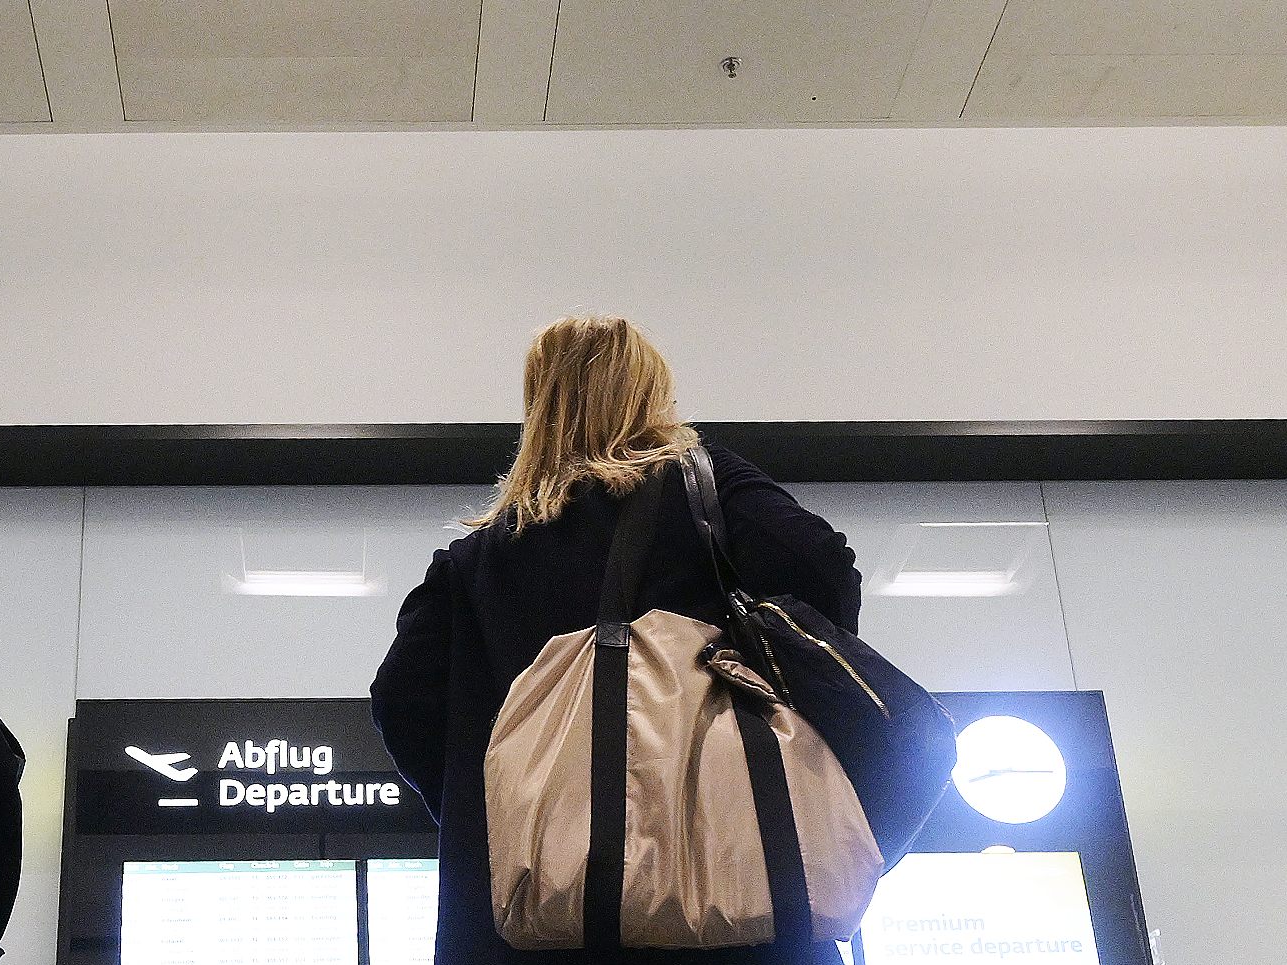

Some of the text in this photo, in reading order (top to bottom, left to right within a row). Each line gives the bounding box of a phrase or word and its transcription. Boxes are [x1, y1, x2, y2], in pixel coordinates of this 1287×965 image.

[218, 740, 333, 775] Abflug
[219, 778, 400, 813] Departure
[882, 913, 985, 932] Premium
[884, 936, 1083, 958] service departure
